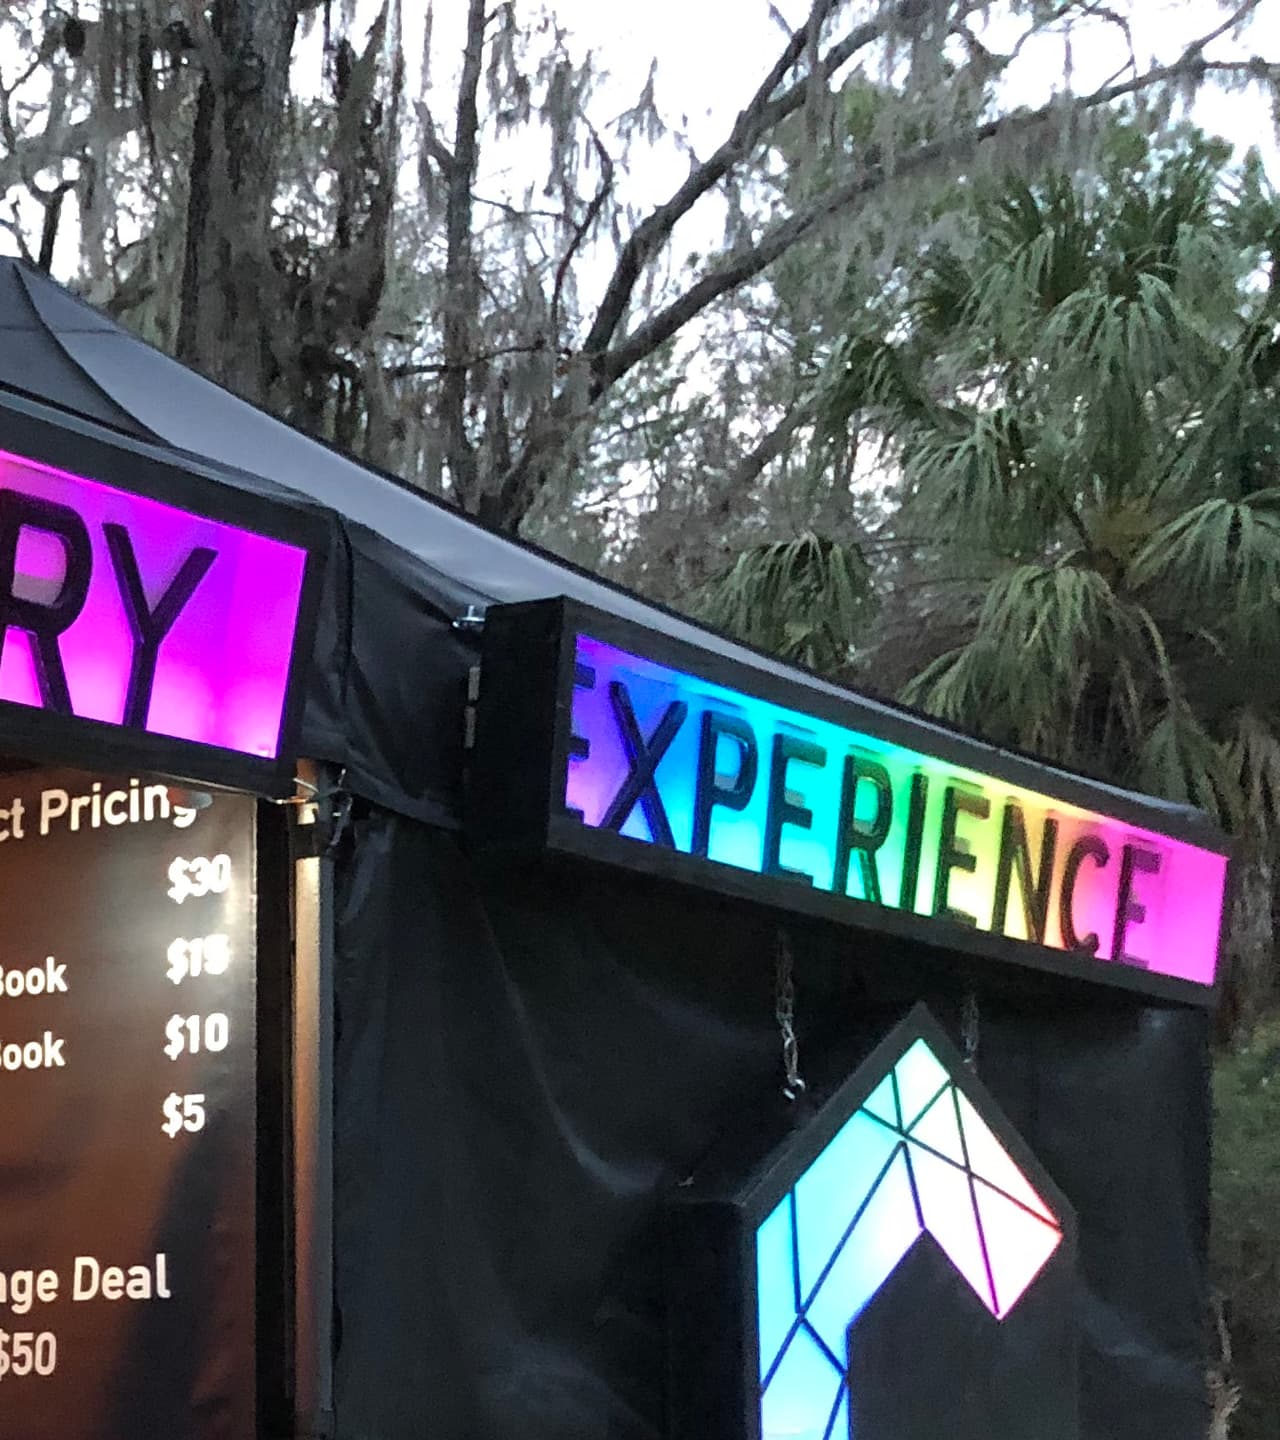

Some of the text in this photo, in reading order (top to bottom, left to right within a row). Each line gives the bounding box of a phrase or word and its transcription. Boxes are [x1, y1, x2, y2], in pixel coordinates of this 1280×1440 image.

[167, 854, 232, 904] $30
[164, 1013, 230, 1060] $10
[161, 1093, 206, 1138] $5
[72, 1253, 171, 1302] Deal
